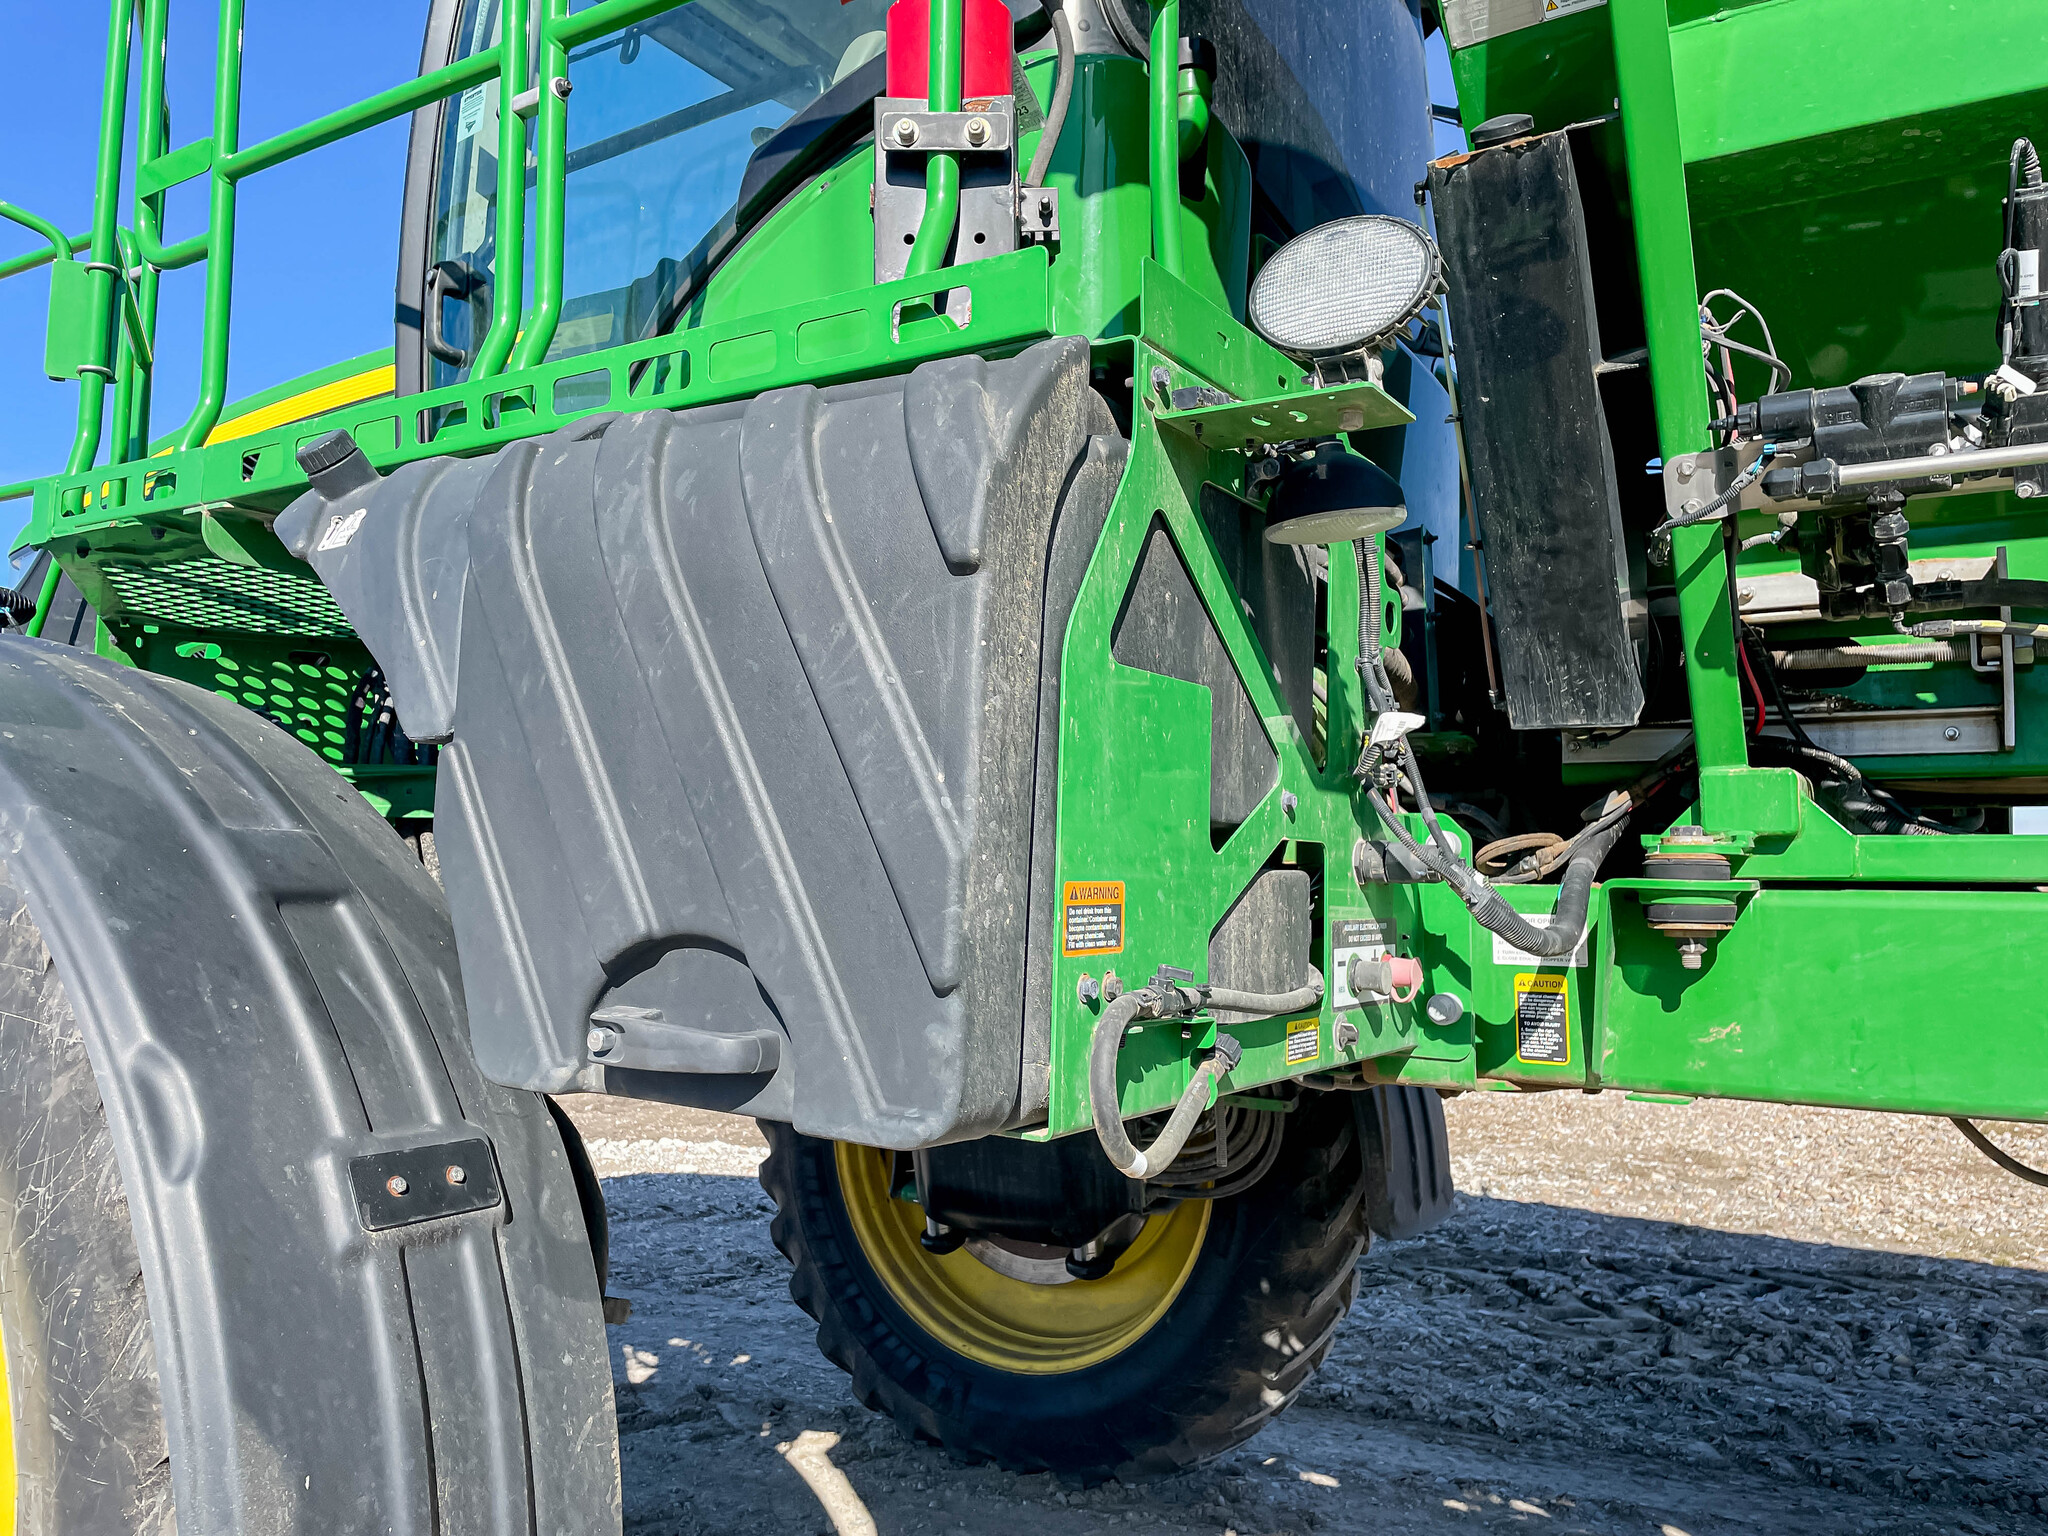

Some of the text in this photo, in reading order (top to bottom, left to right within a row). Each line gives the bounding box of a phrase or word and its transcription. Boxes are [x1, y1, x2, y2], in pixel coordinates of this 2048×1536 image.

[1079, 887, 1119, 900] WARNING
[1104, 906, 1112, 914] this
[1112, 923, 1118, 931] by
[1076, 940, 1084, 948] with
[1528, 980, 1563, 988] CAUTION
